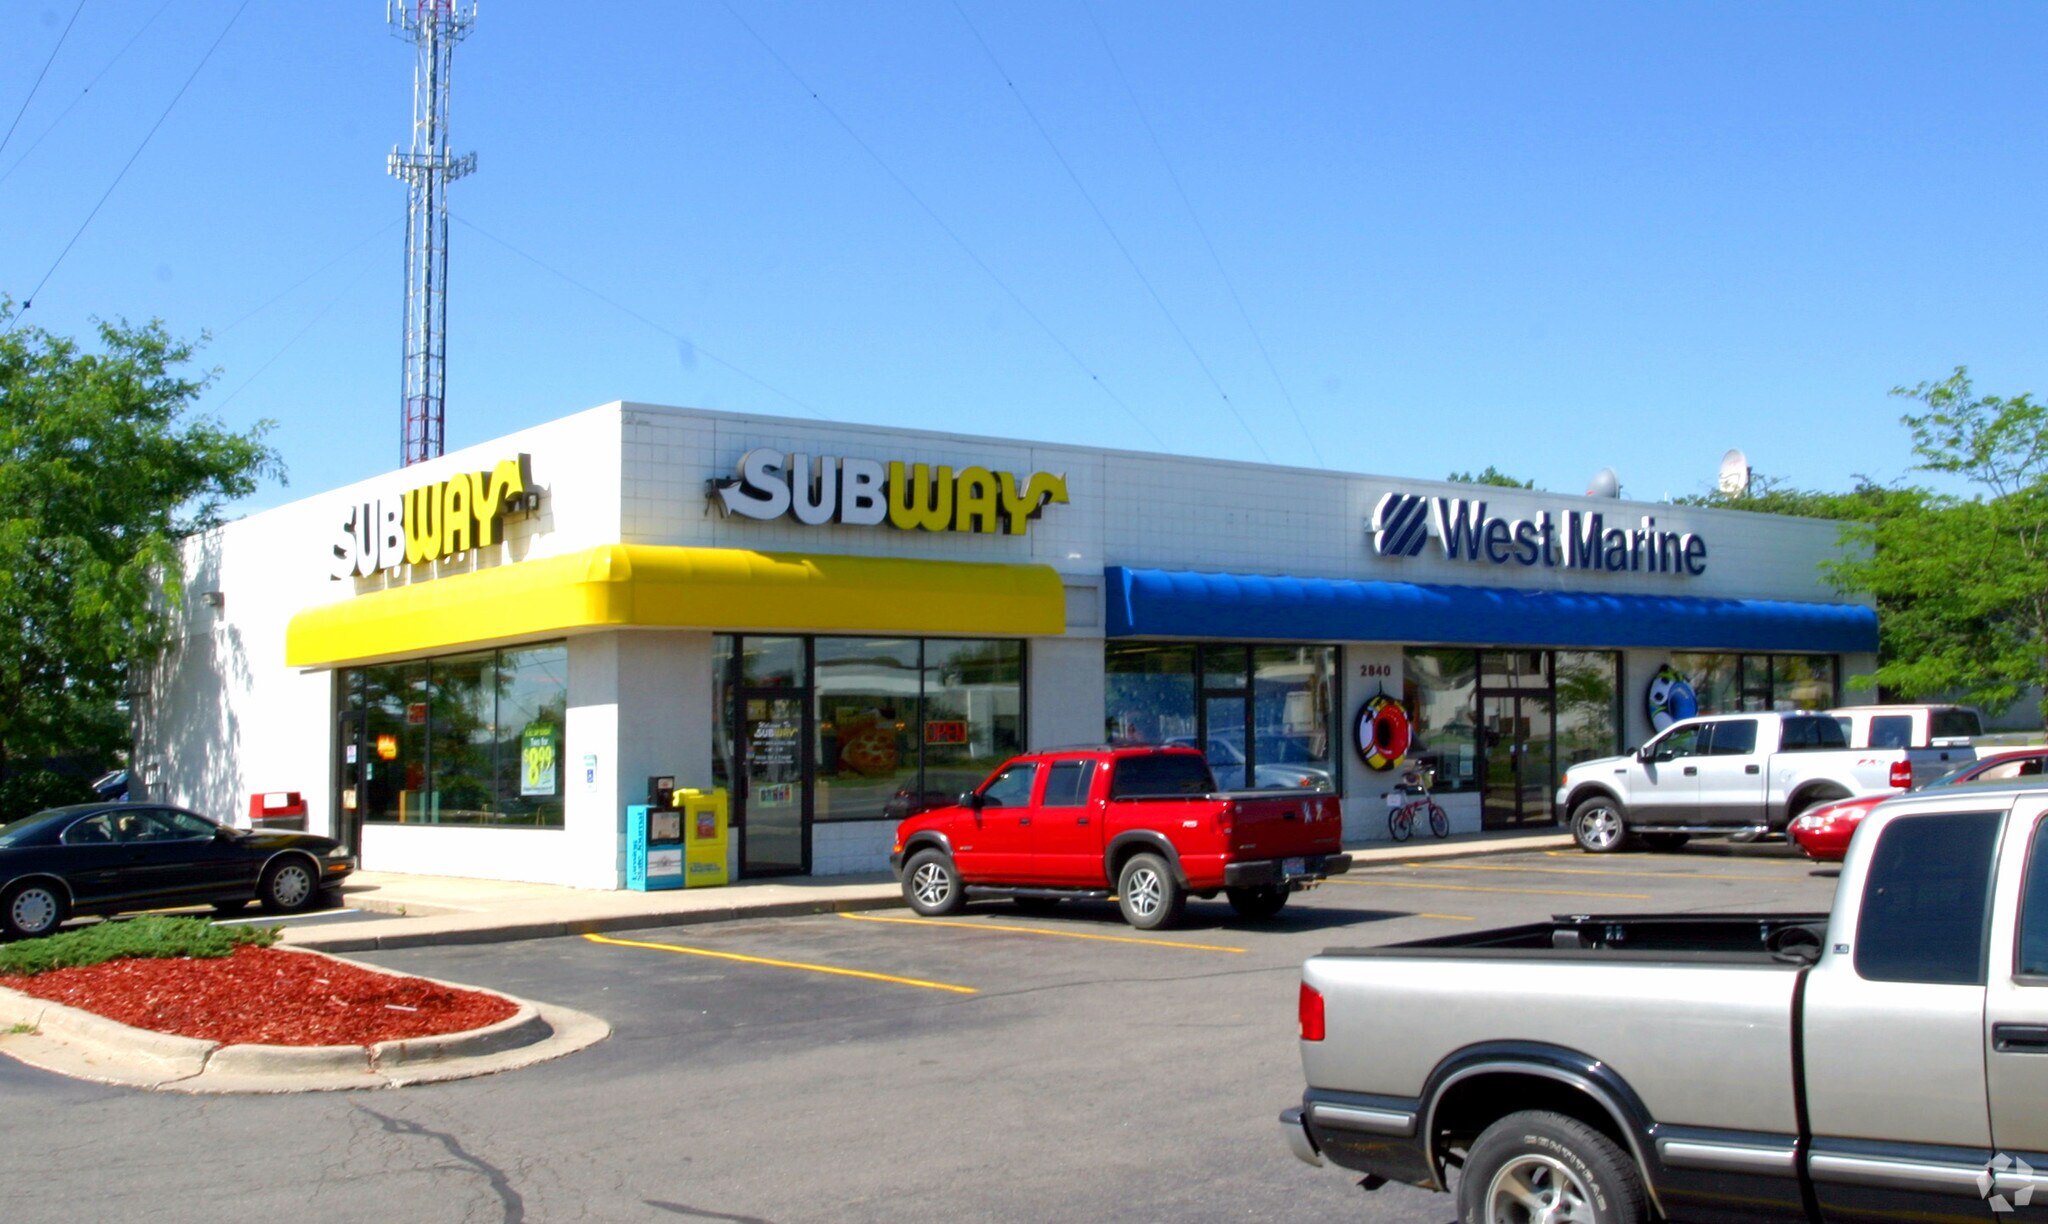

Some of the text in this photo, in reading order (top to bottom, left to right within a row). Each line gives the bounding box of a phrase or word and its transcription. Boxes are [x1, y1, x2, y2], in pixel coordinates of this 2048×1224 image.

[330, 455, 527, 581] SUBWAY
[718, 447, 1070, 536] SUBWAY
[1433, 496, 1707, 576] West Marine
[1360, 664, 1391, 677] 2840
[926, 721, 965, 743] OPEN
